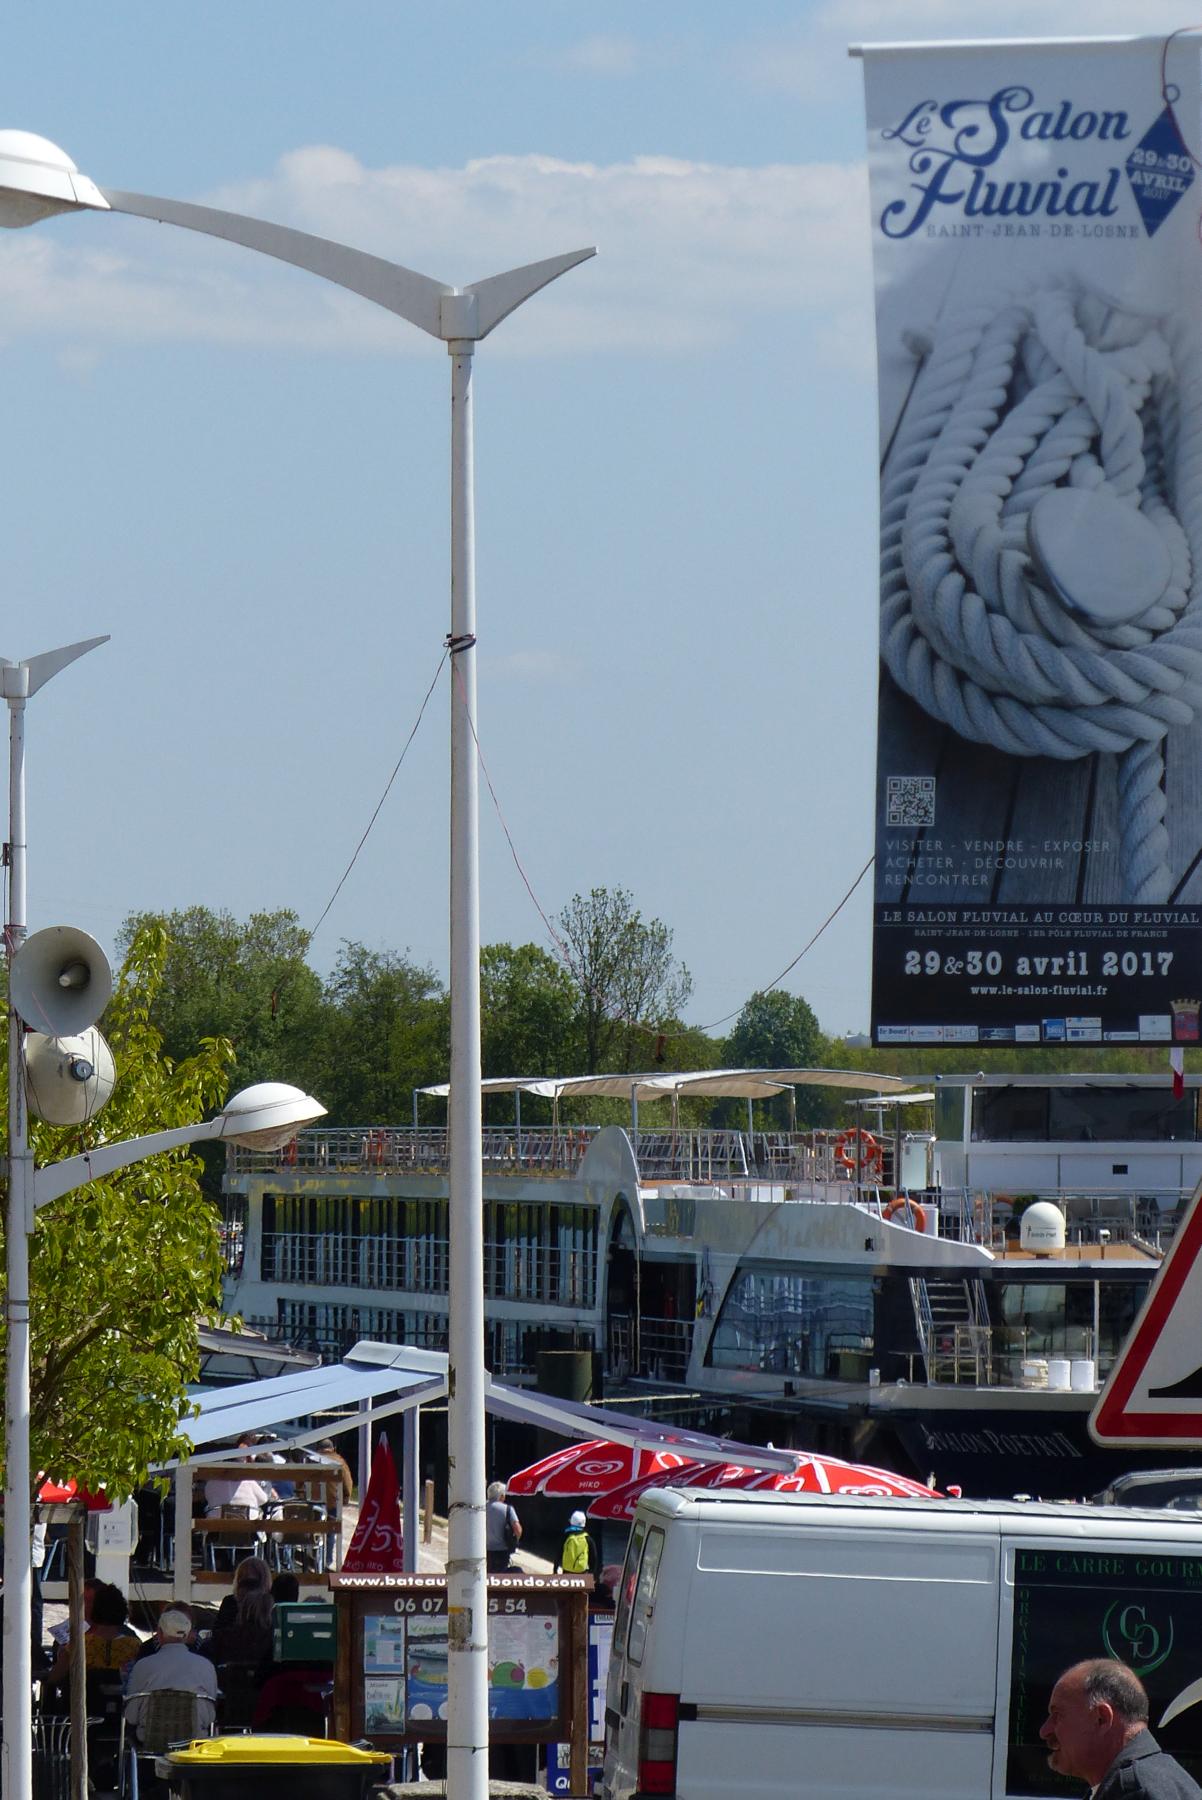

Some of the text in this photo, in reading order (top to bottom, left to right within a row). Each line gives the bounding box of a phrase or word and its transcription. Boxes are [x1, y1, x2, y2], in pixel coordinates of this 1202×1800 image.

[881, 85, 1132, 168] Le Salon
[1130, 168, 1187, 193] AVRIL
[879, 147, 1121, 240] Fluvial
[885, 840, 1110, 852] VISITER VENDRE EXPOSER
[885, 857, 954, 868] ACHETER
[884, 874, 989, 886] RENCONTRER
[883, 911, 902, 922] LE
[907, 911, 957, 922] SALON
[962, 911, 1029, 922] FLUVIAL
[1033, 912, 1053, 923] AU
[1108, 912, 1129, 923] DU
[1134, 912, 1200, 924] FLUVIAL
[1016, 951, 1089, 976] avril
[1103, 952, 1174, 976] 2017
[970, 985, 1108, 996] www.le-salon-fluvial.fr
[1020, 1555, 1046, 1571] LE
[1056, 1558, 1124, 1575] CARRE
[394, 1598, 416, 1612] 06
[422, 1599, 444, 1612] 07
[504, 1600, 527, 1613] 54
